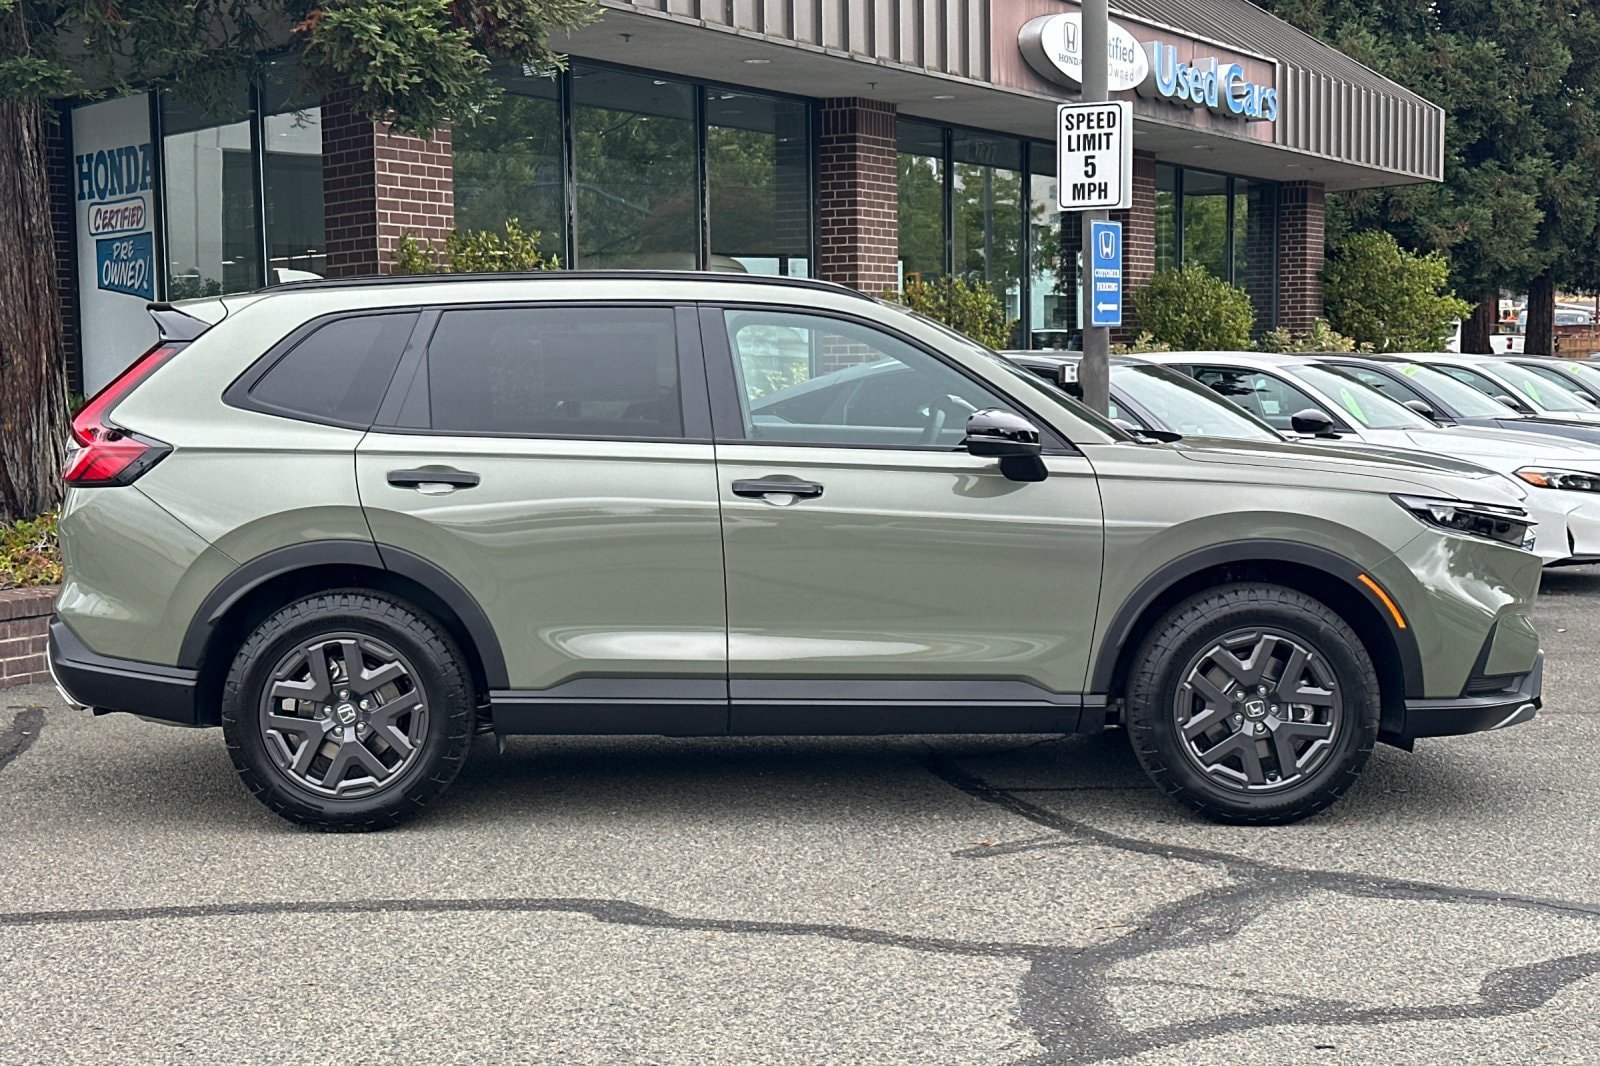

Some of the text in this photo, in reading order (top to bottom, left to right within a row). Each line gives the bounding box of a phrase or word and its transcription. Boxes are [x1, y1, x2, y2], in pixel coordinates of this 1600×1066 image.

[1058, 53, 1082, 66] HOND
[1108, 37, 1135, 63] tified
[1153, 40, 1277, 121] Used Cars
[1065, 111, 1116, 131] SPEED
[1067, 132, 1113, 153] LIMIT
[76, 143, 154, 201] HONDA
[1084, 155, 1097, 178] 5
[1072, 182, 1108, 201] MPH
[94, 205, 143, 232] CERTIFIED
[113, 240, 134, 260] PRE
[102, 256, 150, 290] OWNED!
